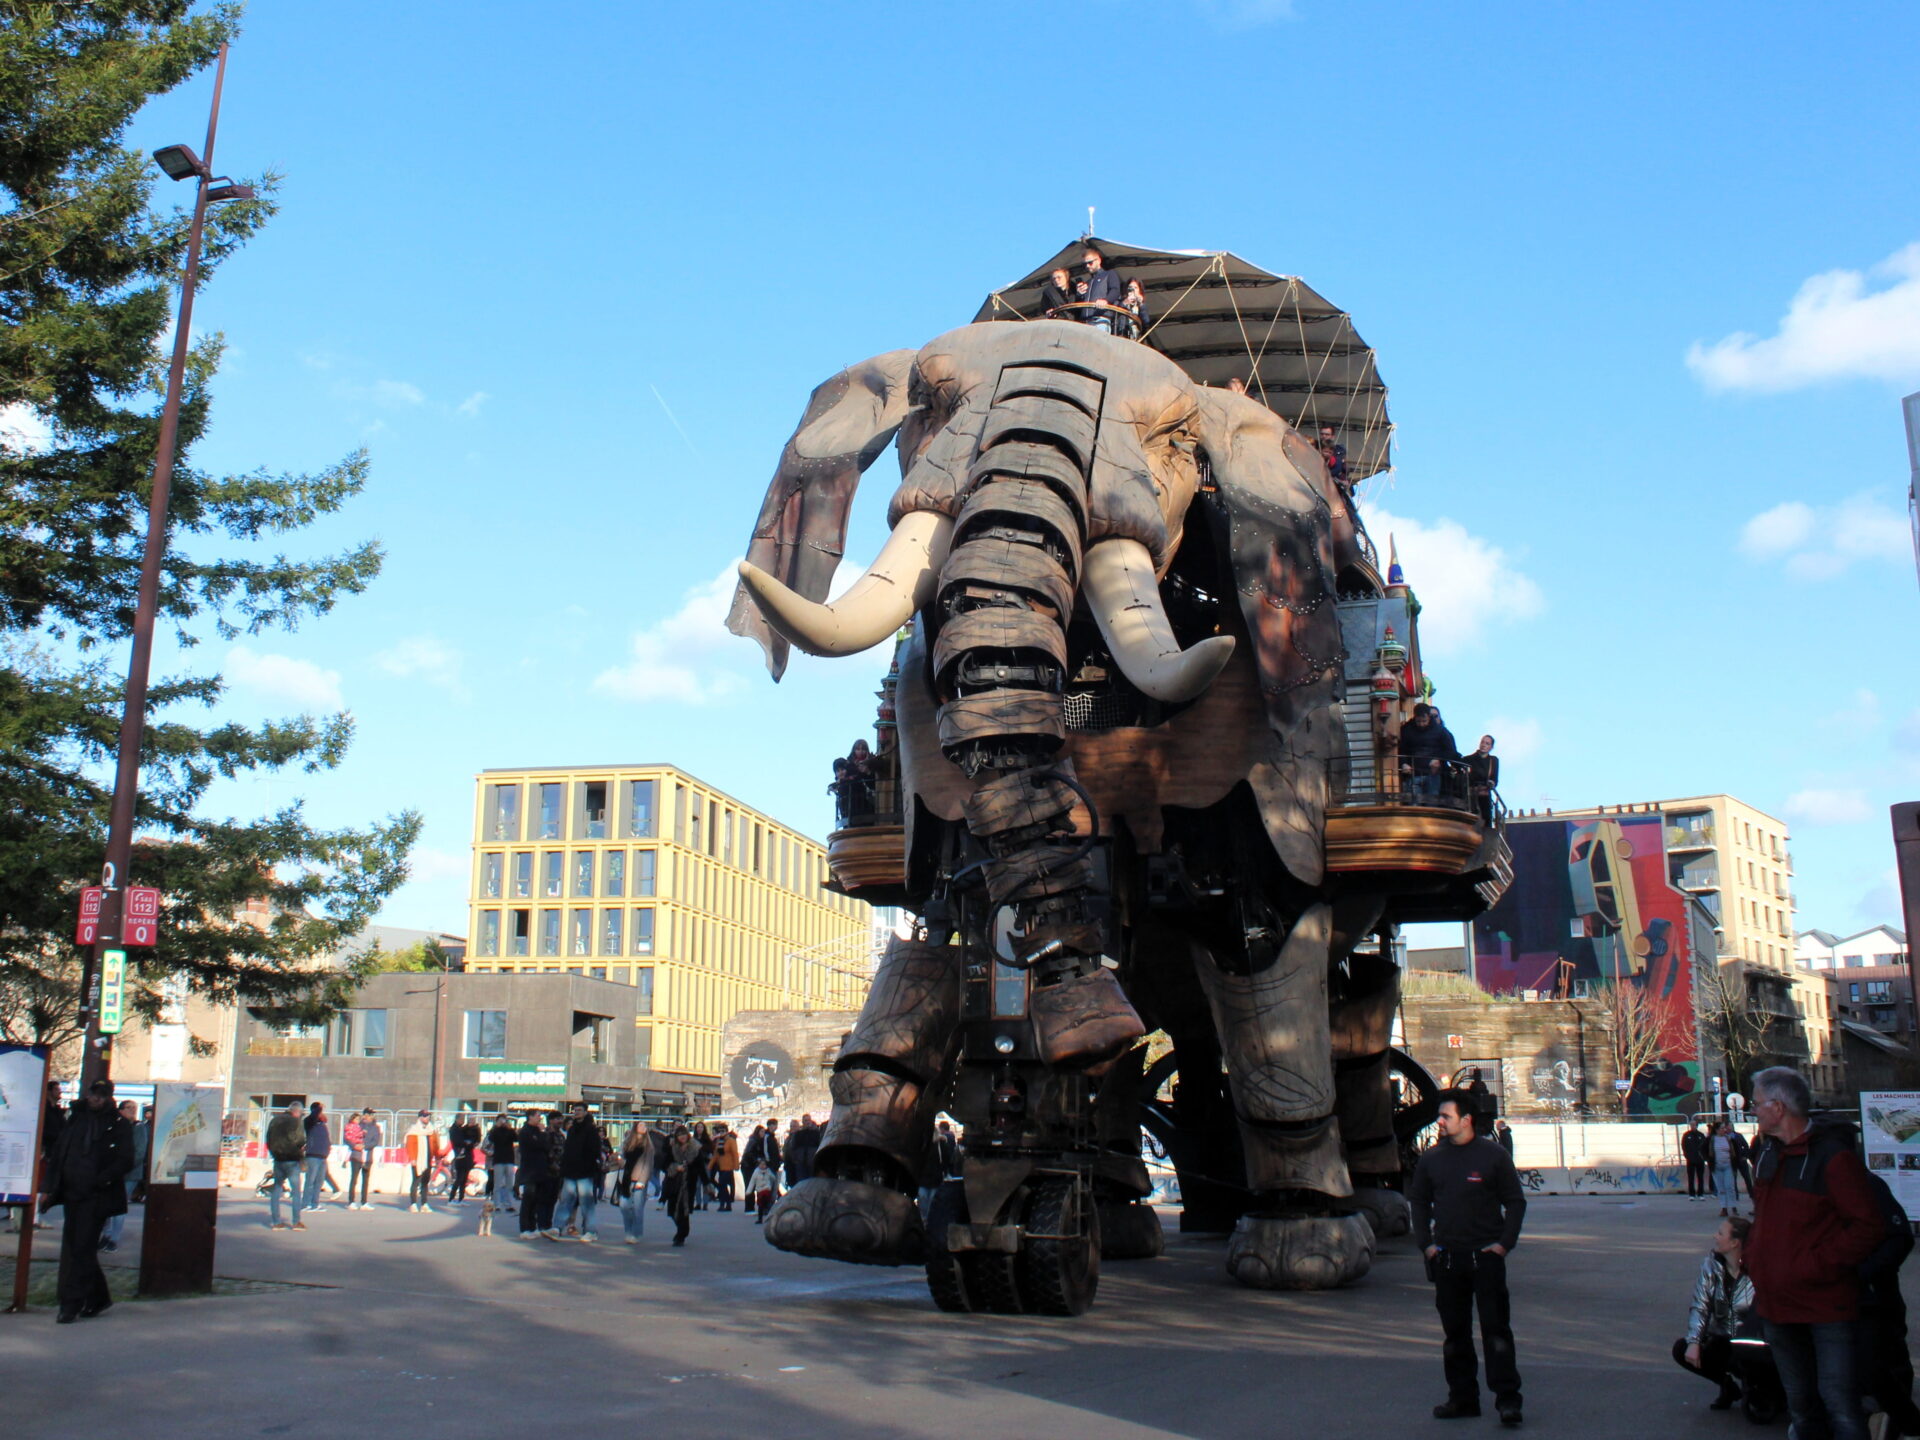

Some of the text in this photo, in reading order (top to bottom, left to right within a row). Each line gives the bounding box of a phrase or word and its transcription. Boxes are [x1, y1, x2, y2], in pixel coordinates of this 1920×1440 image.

[103, 862, 115, 886] Q
[85, 903, 97, 911] 112
[135, 904, 152, 912] 112
[84, 926, 92, 942] Q
[136, 926, 147, 942] Q
[479, 1071, 566, 1086] BIOBURGER
